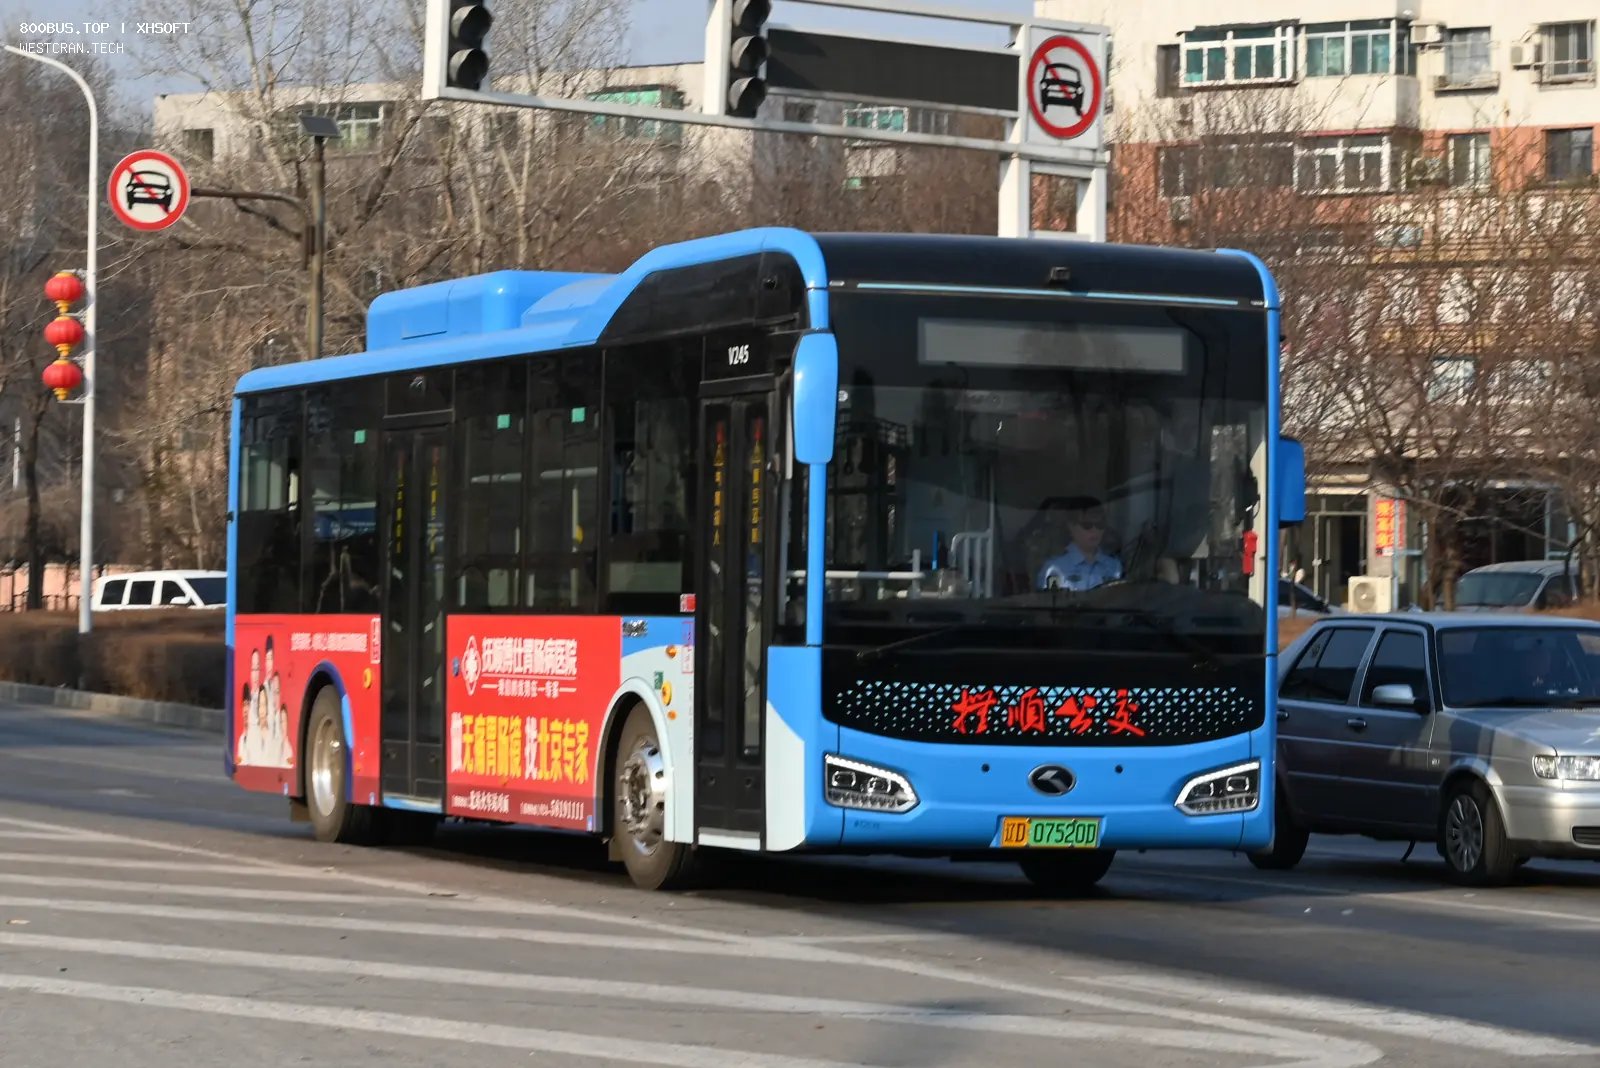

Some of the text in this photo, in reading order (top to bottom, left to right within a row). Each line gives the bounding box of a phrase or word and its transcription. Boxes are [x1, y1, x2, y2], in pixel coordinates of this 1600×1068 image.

[728, 345, 749, 365] V245
[951, 687, 1145, 736] 抚顺公交
[524, 716, 589, 785] 找北京专家
[1004, 822, 1097, 845] 辽D 07520D
